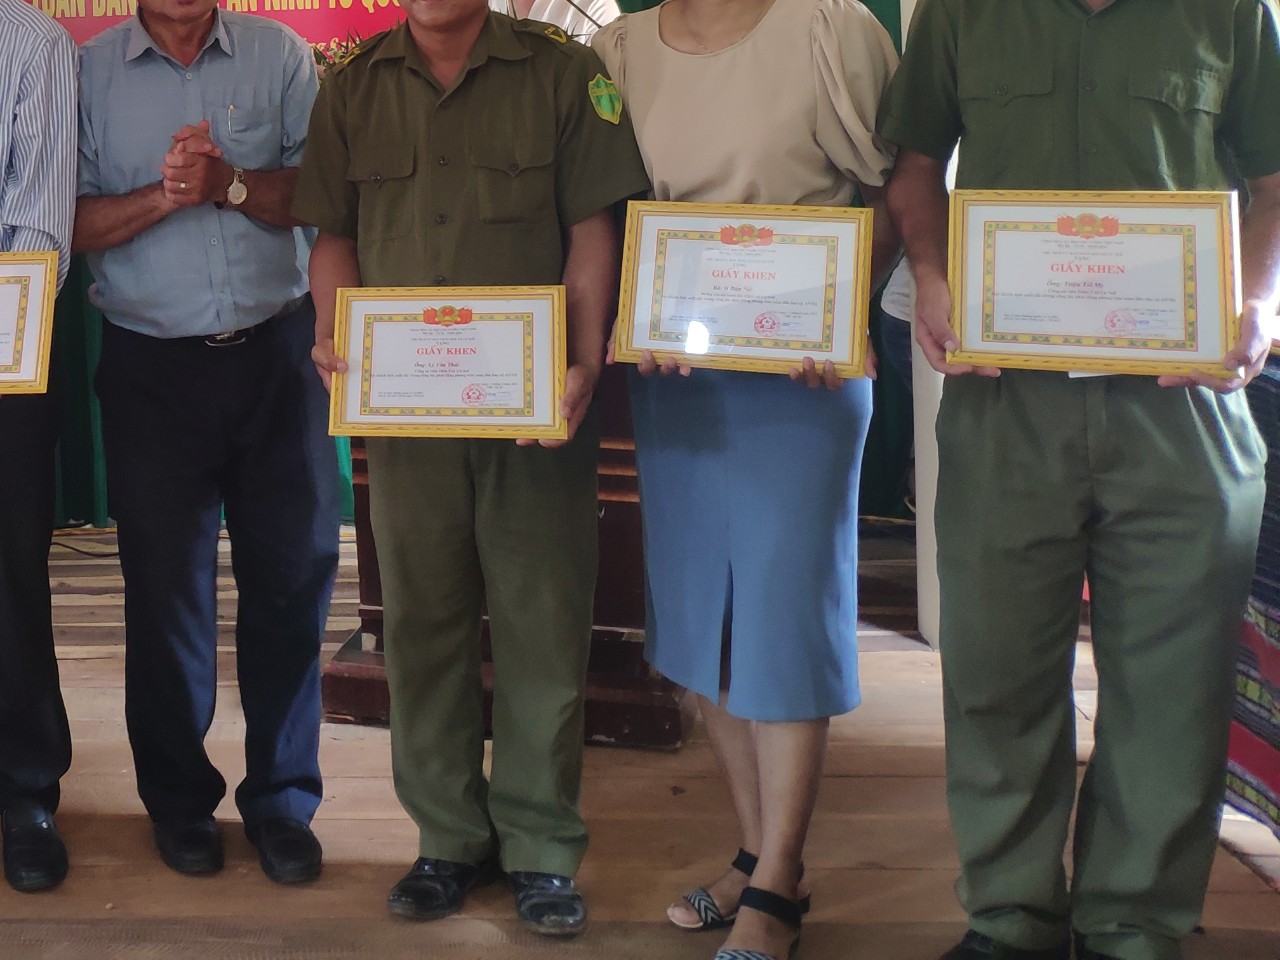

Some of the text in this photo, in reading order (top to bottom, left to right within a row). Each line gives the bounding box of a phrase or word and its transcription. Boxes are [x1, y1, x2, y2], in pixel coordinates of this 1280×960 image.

[1050, 260, 1126, 274] GIẤY KHEN
[743, 271, 777, 280] KHEN
[416, 344, 477, 355] GIẤY KHEN
